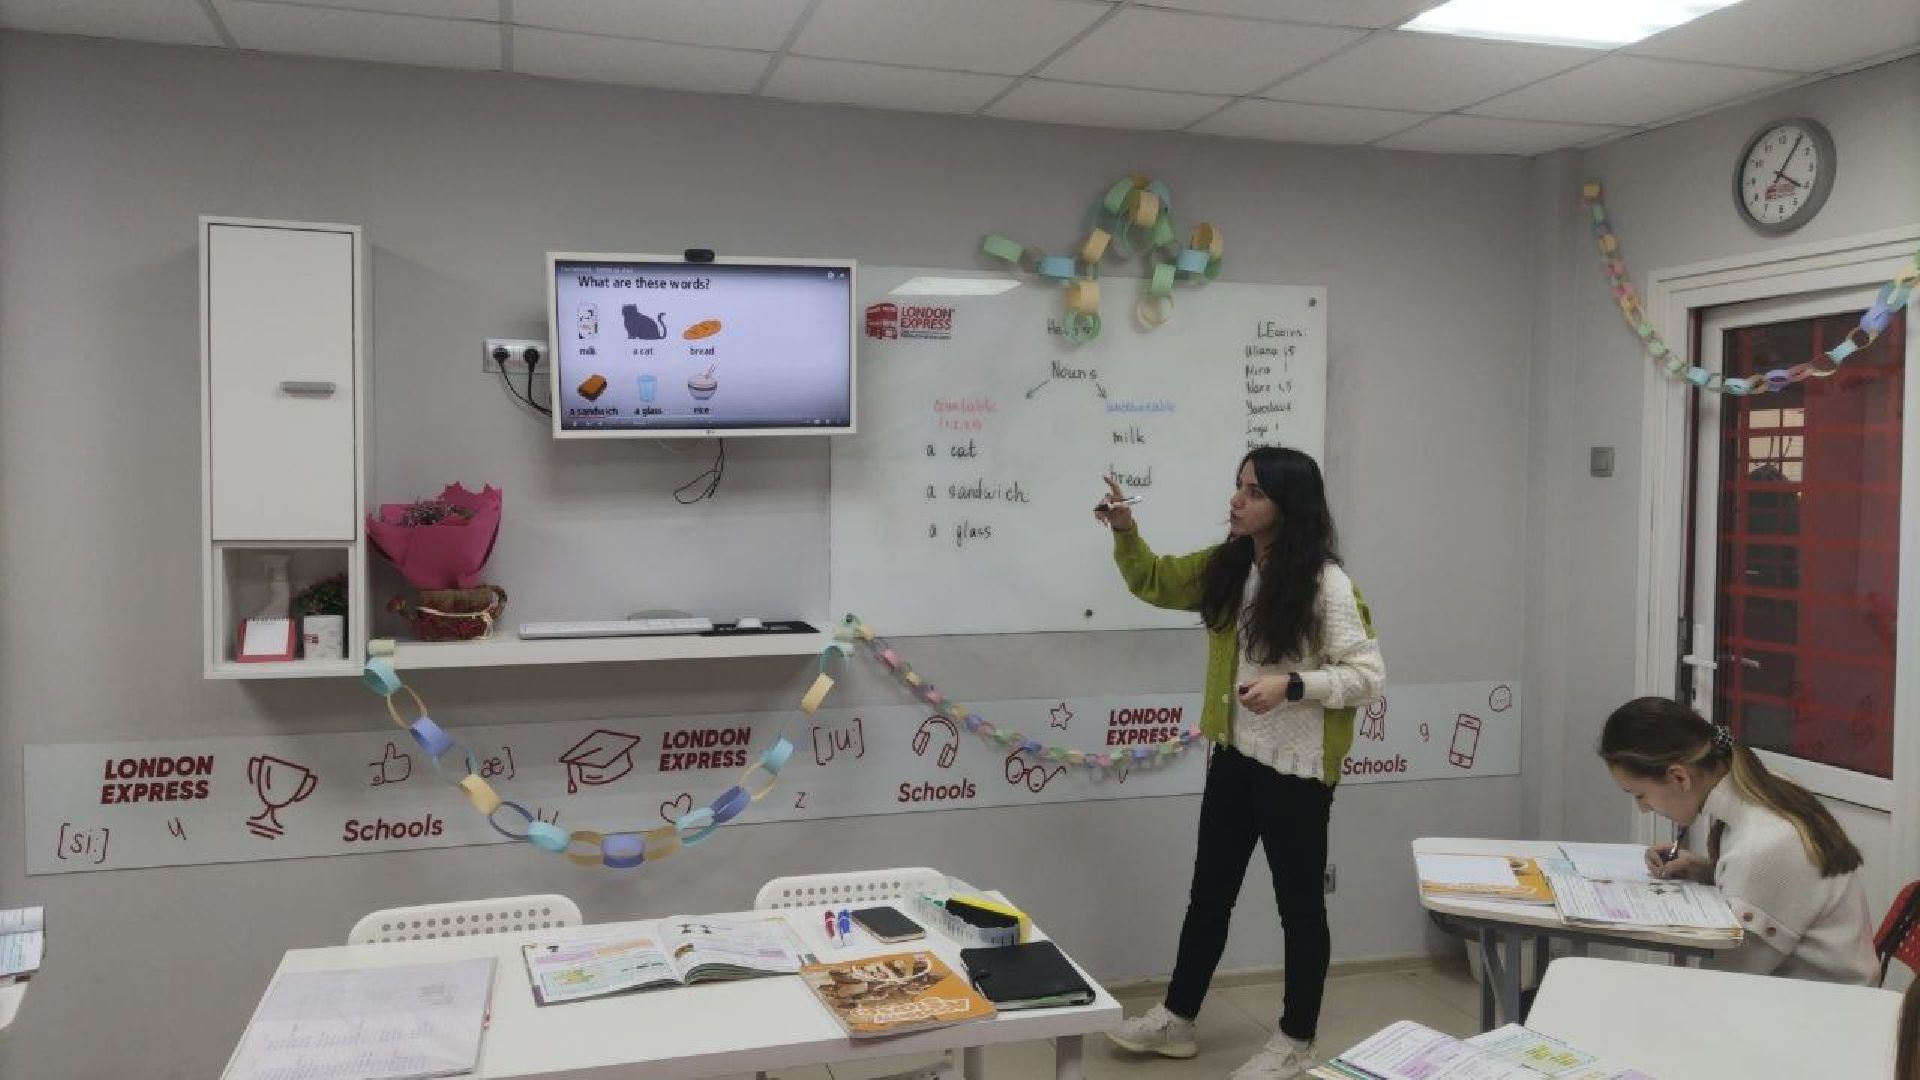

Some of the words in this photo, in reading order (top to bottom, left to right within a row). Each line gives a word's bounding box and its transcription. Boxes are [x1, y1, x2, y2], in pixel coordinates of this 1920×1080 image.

[577, 275, 610, 288] What
[613, 278, 632, 289] are
[636, 276, 667, 289] these
[670, 278, 710, 290] words?
[901, 306, 952, 319] LONDON
[901, 318, 952, 330] EXPRESS
[579, 346, 596, 356] milk
[640, 347, 653, 356] cat
[689, 347, 715, 356] bread
[1051, 360, 1097, 380] Nouns
[577, 407, 619, 416] sandwich
[642, 407, 663, 417] glass
[693, 407, 710, 415] rice
[1112, 426, 1146, 445] milk
[926, 445, 937, 457] a
[951, 438, 977, 458] cat
[926, 485, 937, 499] a
[949, 477, 1031, 502] sandwich
[929, 523, 937, 538] a
[956, 519, 992, 547] glass
[1109, 706, 1183, 726] LONDON
[662, 726, 751, 750] LONDON
[104, 756, 214, 780] LONDON
[659, 750, 748, 772] EXPRESS
[1342, 754, 1408, 776] Schools
[101, 780, 209, 804] EXPRESS
[898, 778, 976, 803] Schools
[342, 813, 443, 842] Schools
